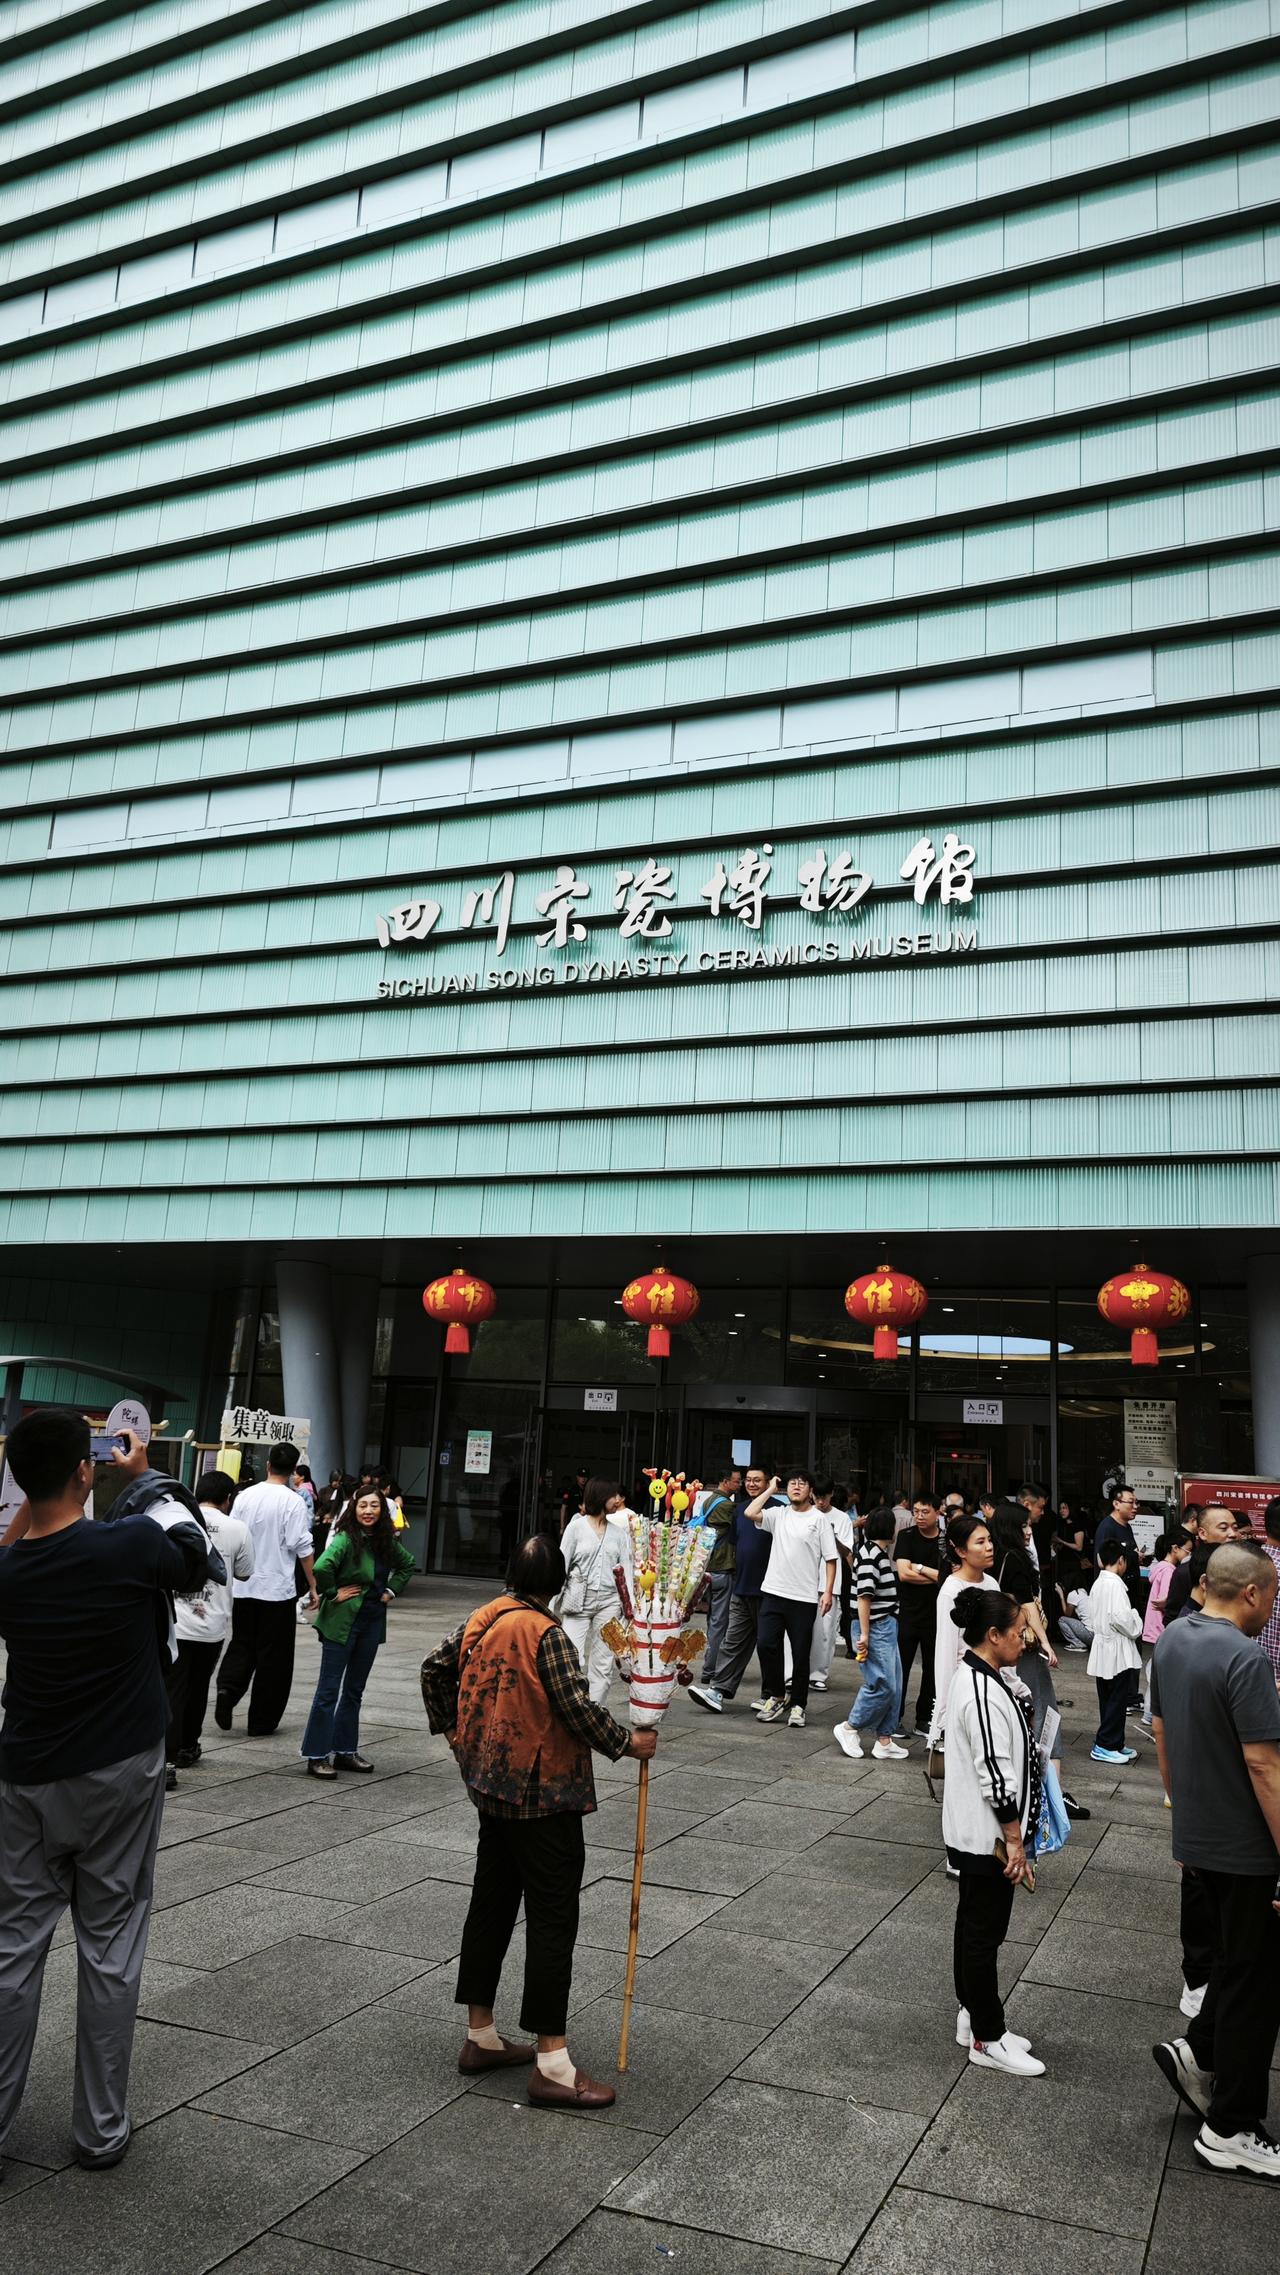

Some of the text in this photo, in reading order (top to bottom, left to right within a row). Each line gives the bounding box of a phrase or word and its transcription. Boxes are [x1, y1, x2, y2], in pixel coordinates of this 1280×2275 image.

[375, 833, 977, 957] 四川宋瓷博物馆
[376, 929, 978, 999] SICHUAN SONG DYNASTY CERAMICS MUSEUM
[230, 1405, 295, 1442] 集章领取
[967, 1402, 985, 1410] 入口
